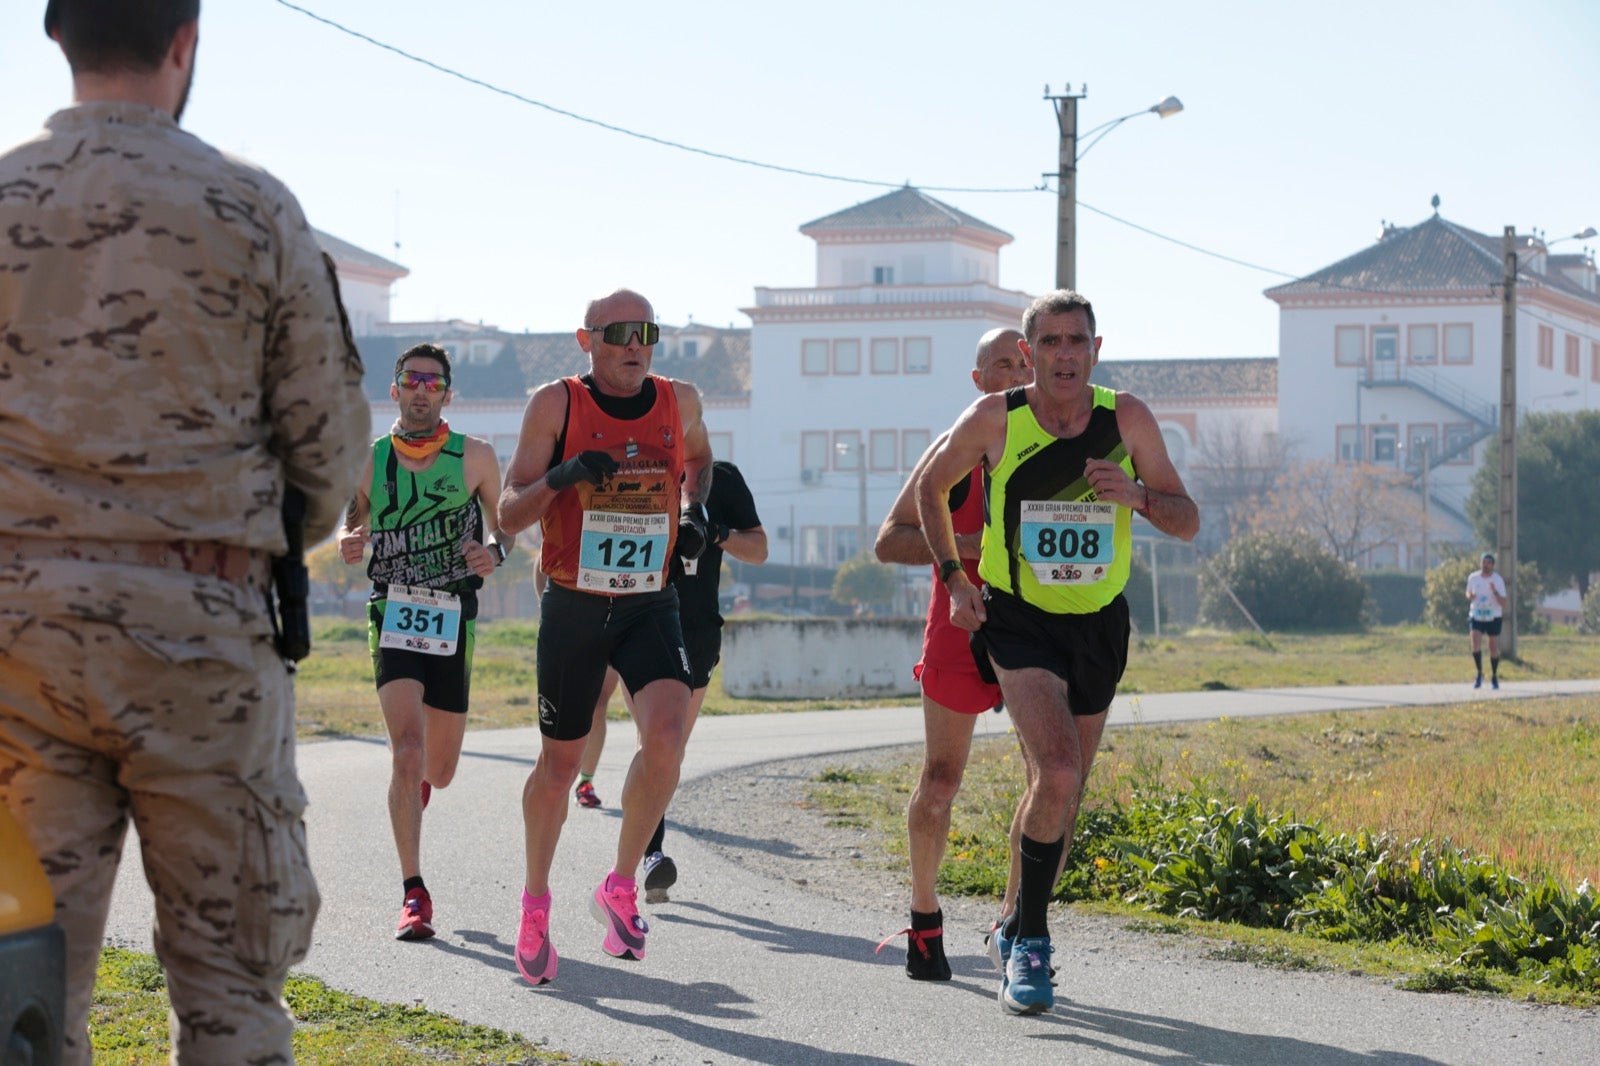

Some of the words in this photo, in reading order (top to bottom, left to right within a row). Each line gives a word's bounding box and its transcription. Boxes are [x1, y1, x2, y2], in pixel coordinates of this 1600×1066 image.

[1045, 503, 1061, 512] GRAN
[1062, 503, 1084, 513] PREMIO
[1084, 504, 1091, 513] DE
[1093, 505, 1112, 514] FONDO
[606, 514, 622, 524] GRAN
[622, 515, 644, 526] PREMIO
[644, 516, 650, 526] DE
[651, 516, 666, 525] FONDO
[1053, 512, 1087, 522] DIPUTACIÓN
[613, 523, 647, 535] DIPUTACIÓN
[1037, 528, 1100, 559] 808
[598, 538, 653, 568] 121
[396, 606, 445, 635] 351
